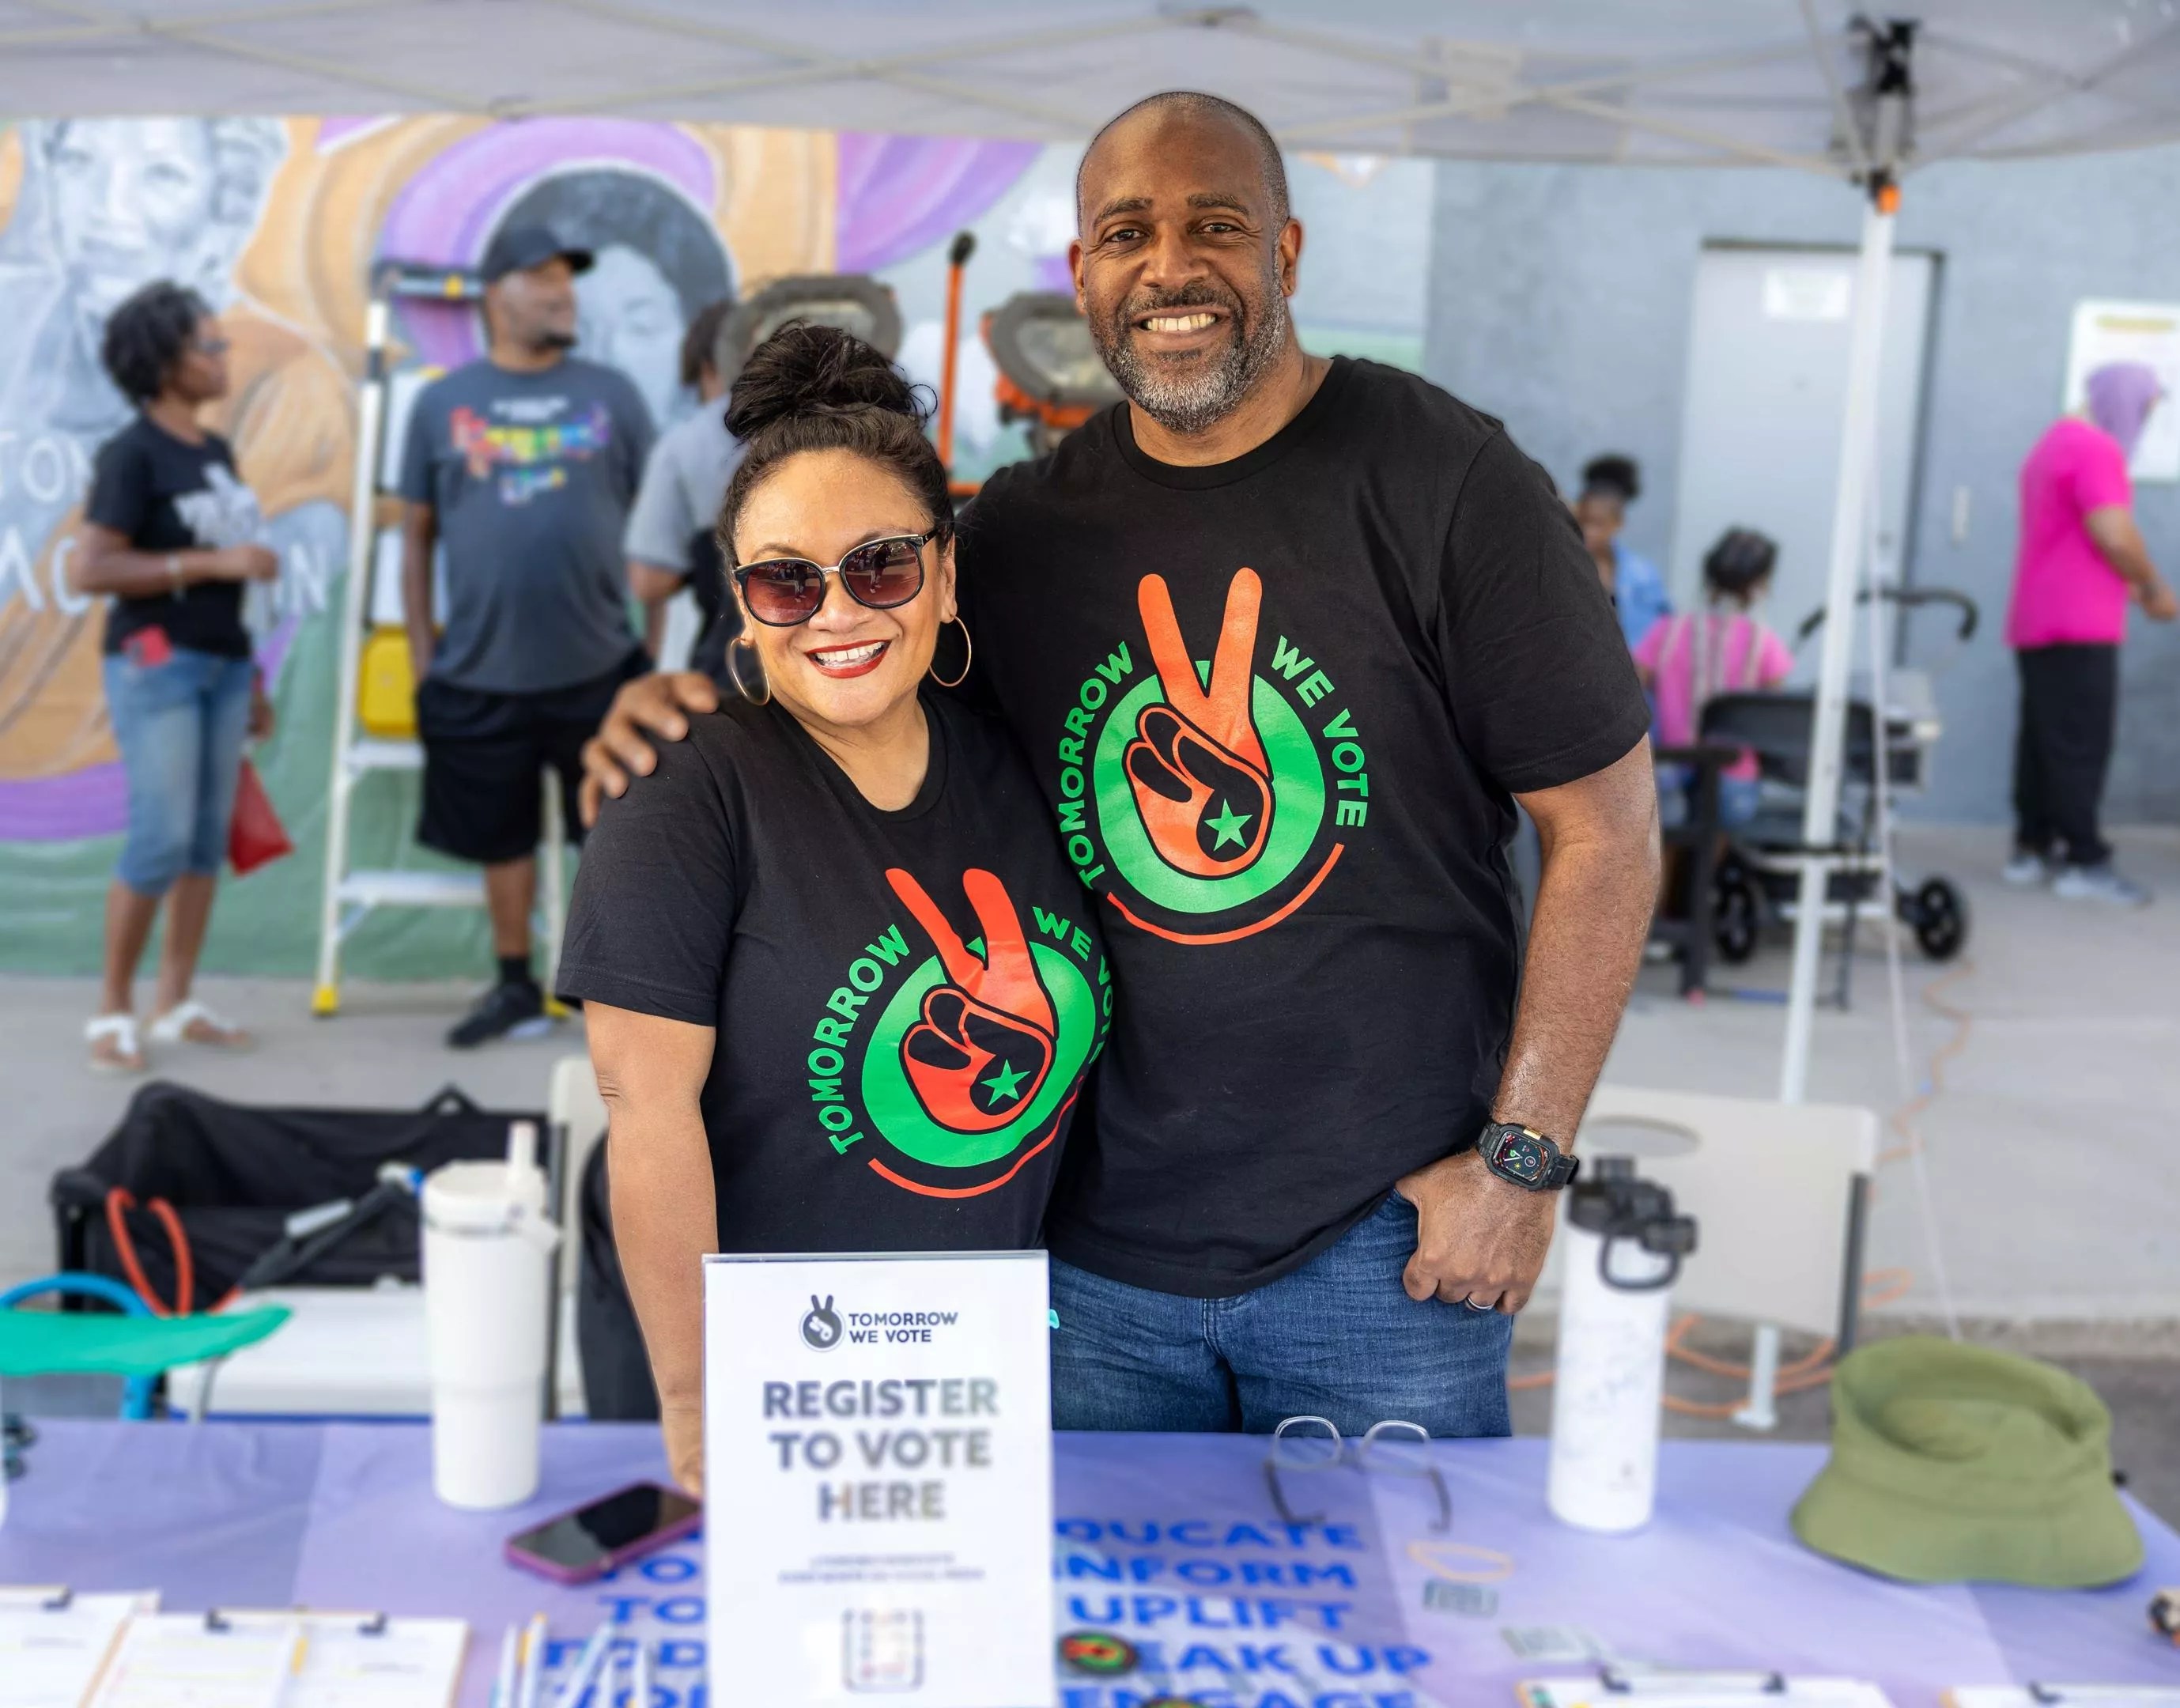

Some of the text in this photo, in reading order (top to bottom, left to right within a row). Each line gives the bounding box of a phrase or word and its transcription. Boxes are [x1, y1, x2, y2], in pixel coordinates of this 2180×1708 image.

[1058, 635, 1370, 890] TOMORROW WE VOTE
[807, 923, 911, 1155] TOMORROW
[1032, 906, 1093, 962] WE
[848, 1310, 958, 1328] TOMORROW
[849, 1328, 932, 1343] WE VOTE
[761, 1377, 999, 1421] REGISTER
[768, 1428, 993, 1472] TO VOTE
[818, 1479, 947, 1523] HERE
[1055, 1517, 1366, 1550] DUCATE
[1067, 1596, 1353, 1631] UPLIFT
[1316, 1645, 1433, 1676] UP
